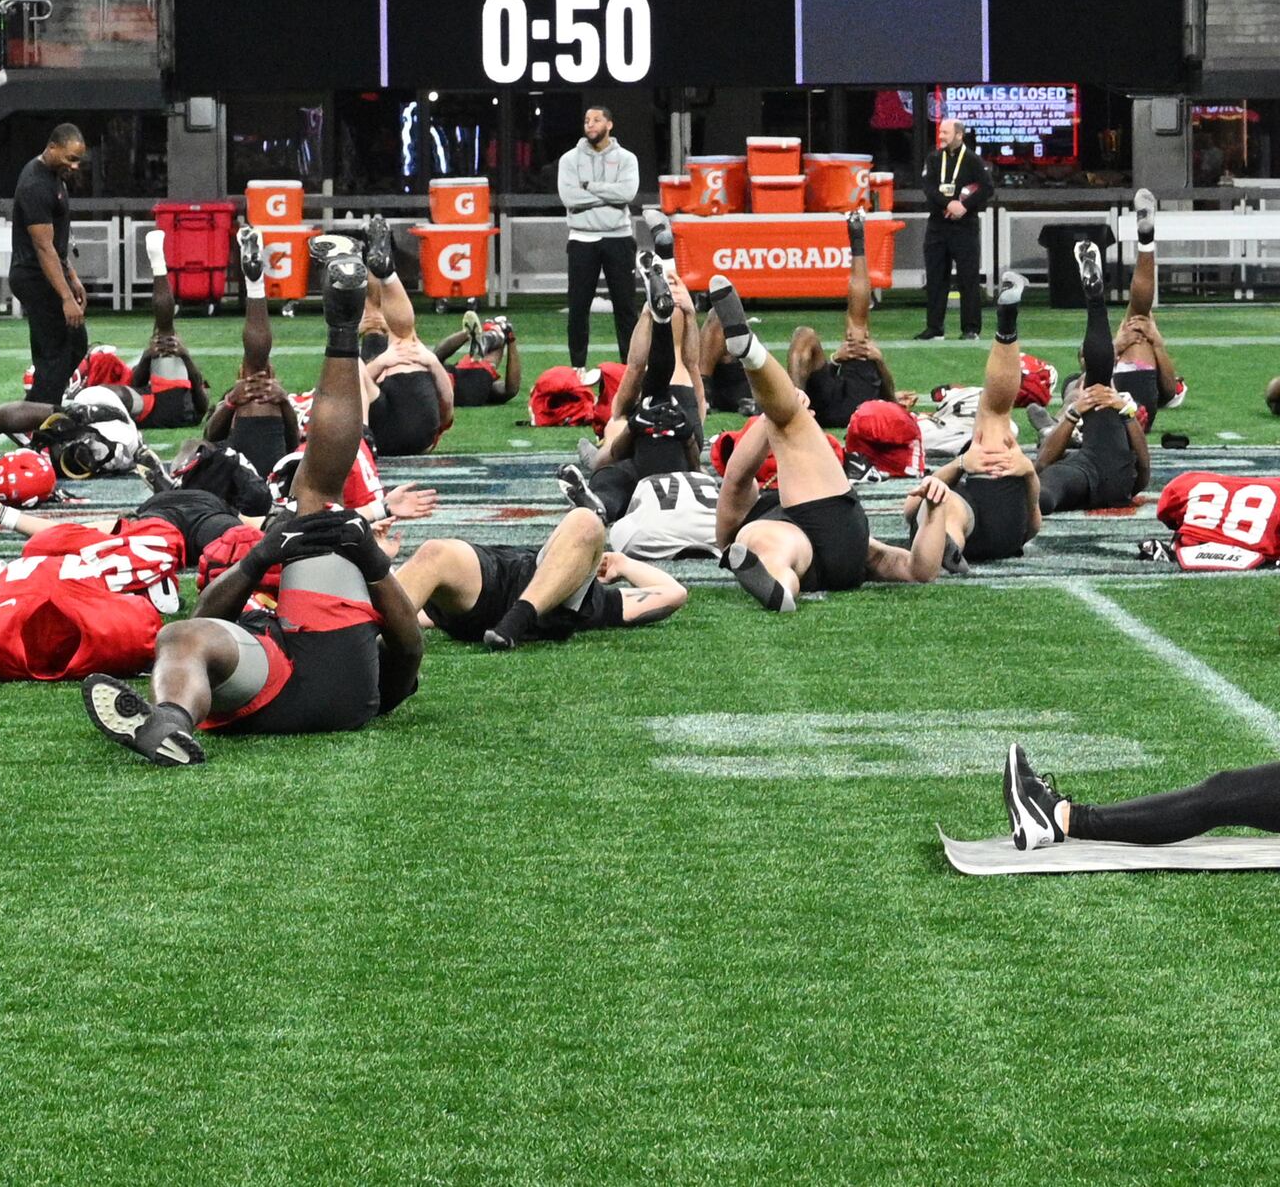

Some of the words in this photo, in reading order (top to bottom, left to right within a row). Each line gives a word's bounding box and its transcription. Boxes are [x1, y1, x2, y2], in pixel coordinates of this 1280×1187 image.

[946, 87, 989, 100] BOWL
[992, 87, 1006, 100] IS
[1009, 87, 1066, 100] CLOSED
[706, 170, 723, 190] G
[265, 194, 287, 217] G
[454, 193, 475, 216] G
[263, 241, 292, 280] G
[437, 243, 471, 281] G
[1183, 481, 1277, 545] 88
[1195, 551, 1243, 562] DOUGLAS
